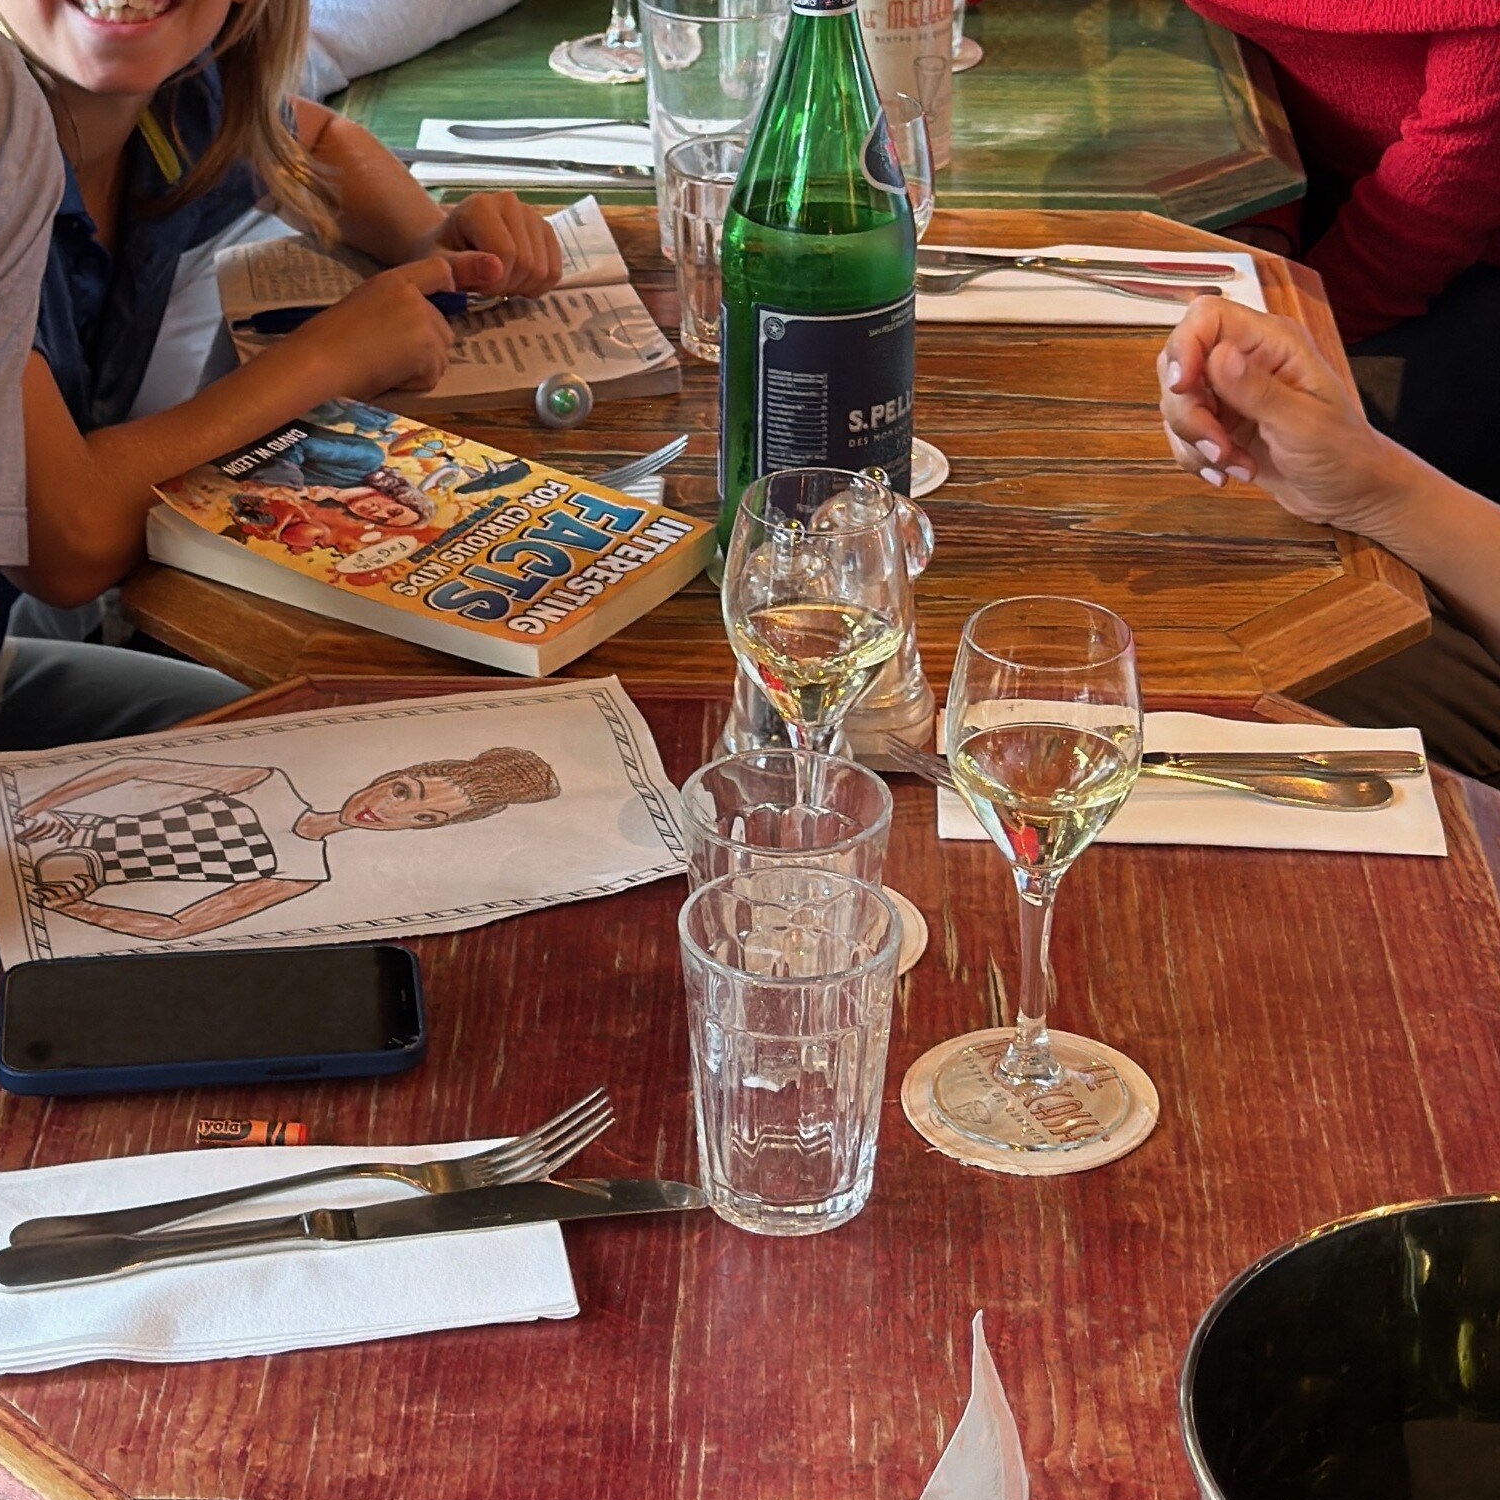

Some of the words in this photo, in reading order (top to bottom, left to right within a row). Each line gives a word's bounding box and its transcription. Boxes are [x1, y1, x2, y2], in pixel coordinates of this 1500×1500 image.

[266, 428, 309, 452] DAVID
[221, 454, 261, 476] LEON
[519, 479, 571, 510] FOR
[439, 505, 532, 566] CURIOUS
[424, 492, 649, 622] FACTS
[506, 516, 695, 635] INTERESTING
[391, 560, 453, 598] KIDS
